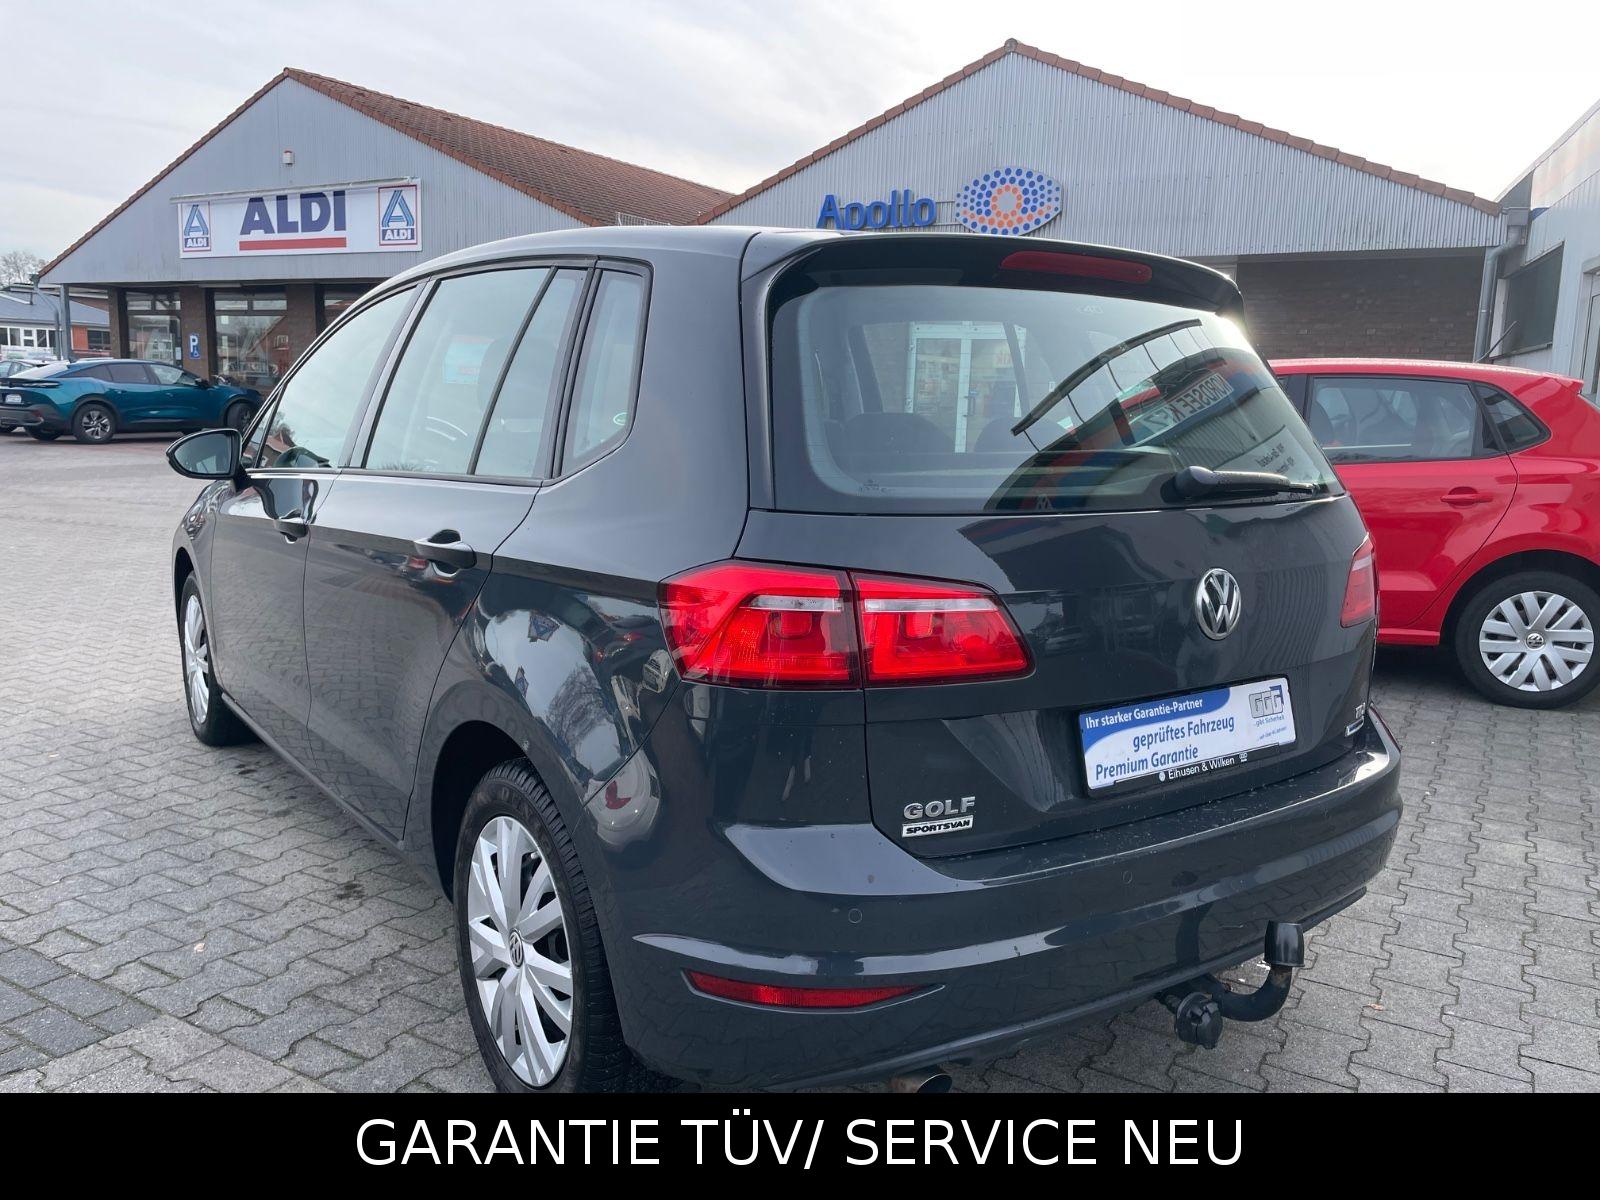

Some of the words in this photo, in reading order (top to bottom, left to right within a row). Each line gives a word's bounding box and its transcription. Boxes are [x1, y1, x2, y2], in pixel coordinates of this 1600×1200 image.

[240, 190, 347, 235] ALDI
[816, 189, 937, 230] Apollo
[186, 237, 208, 249] ALDI
[384, 228, 411, 241] ALDI
[190, 335, 199, 353] P
[1085, 716, 1099, 729] Ihr
[1100, 711, 1133, 727] starker
[1133, 699, 1203, 720] Garantie-Partner
[1133, 725, 1186, 753] geprüftes
[1187, 716, 1235, 741] Fahrzeug
[1095, 757, 1148, 781] Premium
[1151, 744, 1198, 768] Garantie
[1201, 760, 1209, 773] &
[1209, 757, 1235, 771] Wilken
[903, 796, 976, 820] GOLF
[906, 819, 971, 835] SPORTSVAN
